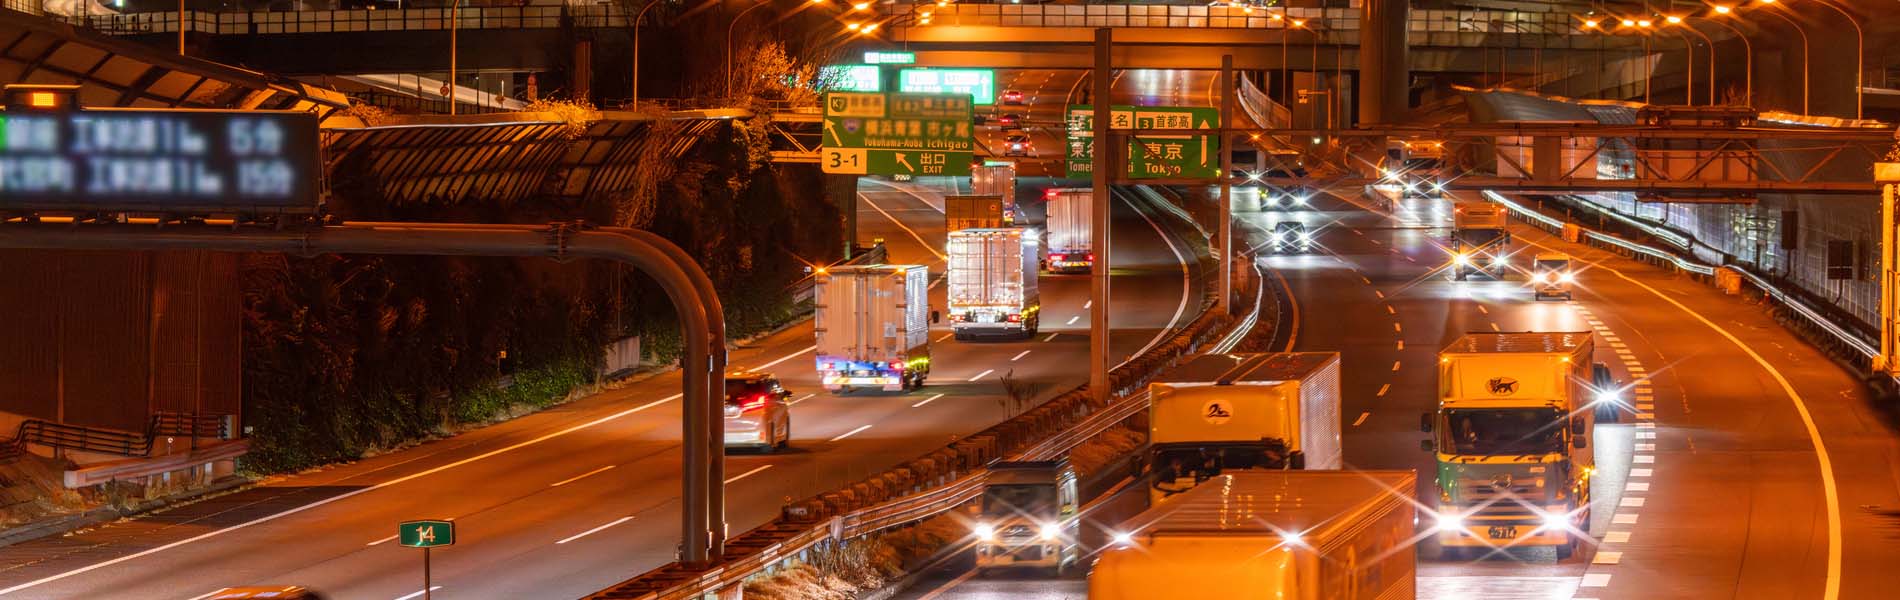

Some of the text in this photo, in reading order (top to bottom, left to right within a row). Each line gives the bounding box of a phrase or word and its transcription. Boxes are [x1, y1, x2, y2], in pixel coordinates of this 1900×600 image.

[1156, 115, 1189, 128] 首都高
[927, 139, 968, 150] Ichigao
[1143, 142, 1183, 160] 東京
[830, 152, 858, 168] 3-1
[920, 153, 945, 165] 出口
[923, 165, 943, 174] EXIT
[1145, 163, 1181, 176] Tokyo
[415, 525, 436, 543] 14
